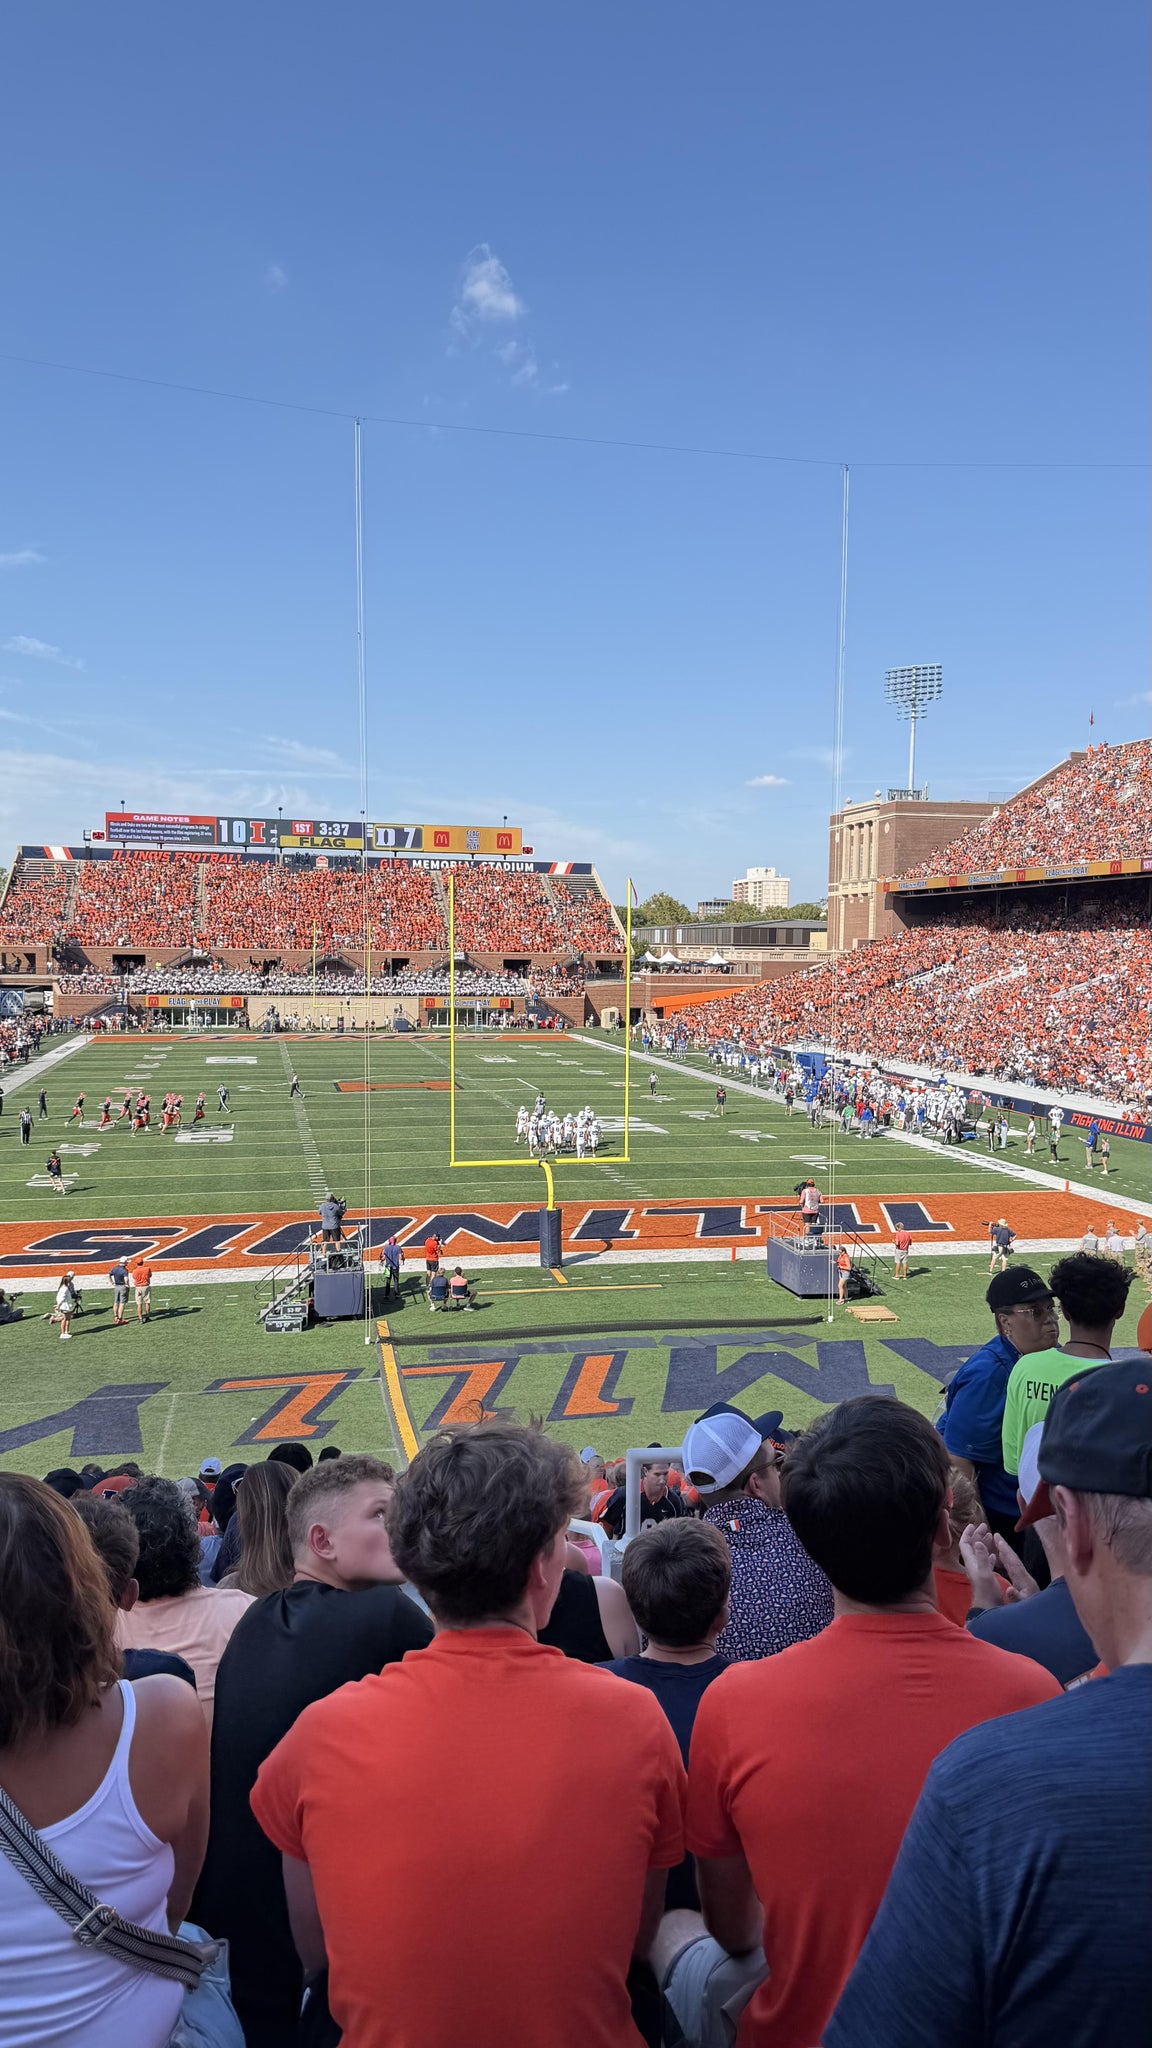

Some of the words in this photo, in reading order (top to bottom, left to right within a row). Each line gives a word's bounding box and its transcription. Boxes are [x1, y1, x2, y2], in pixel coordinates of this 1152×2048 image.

[220, 820, 246, 843] 10
[294, 824, 311, 833] 1ST
[319, 823, 350, 836] 3:37
[299, 837, 346, 848] FLAG
[403, 828, 416, 848] 7
[112, 850, 171, 862] ILLINOIS
[168, 998, 186, 1006] FLAG
[1071, 1113, 1114, 1133] FIGHING
[1114, 1122, 1146, 1140] ILLINI
[0, 1202, 954, 1267] ILLINOIS
[1027, 1381, 1060, 1401] EVEN
